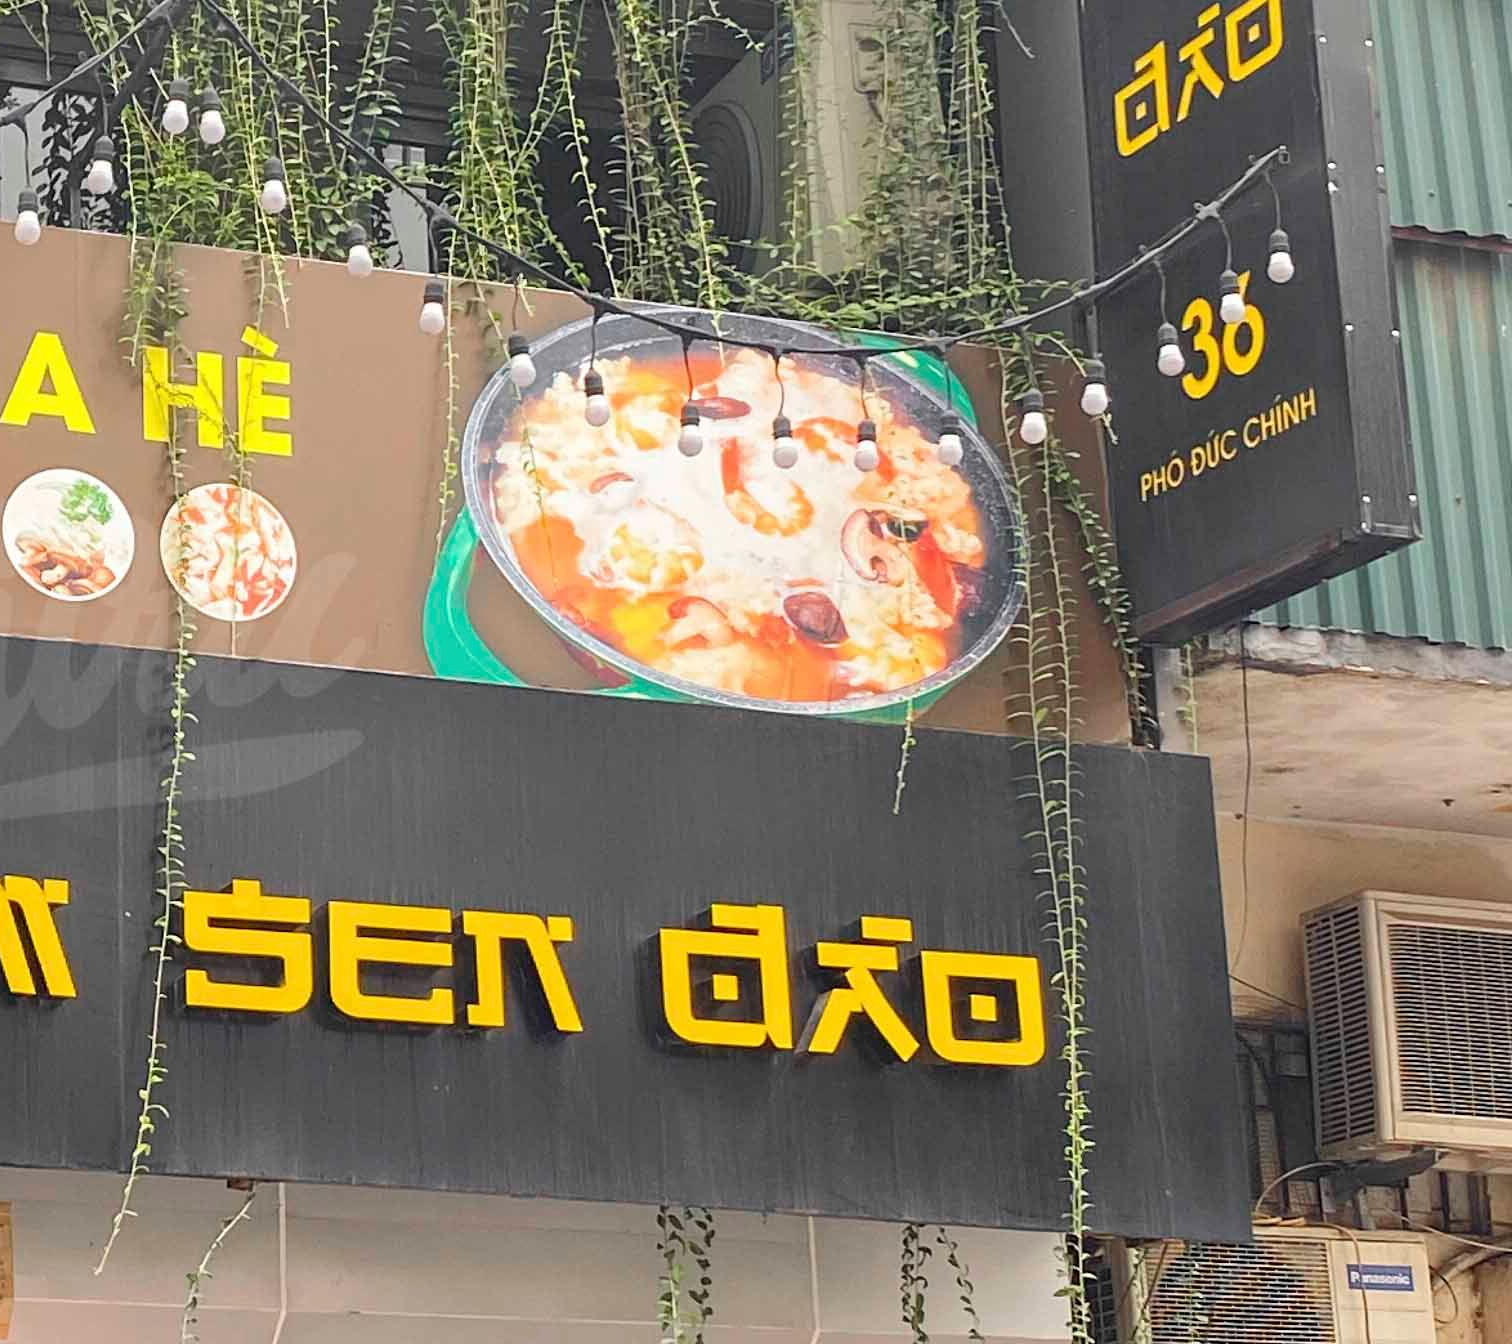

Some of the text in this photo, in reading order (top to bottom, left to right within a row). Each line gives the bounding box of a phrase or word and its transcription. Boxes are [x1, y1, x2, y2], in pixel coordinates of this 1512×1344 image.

[141, 325, 294, 458] HÈ
[1181, 268, 1266, 400] 36
[1140, 387, 1318, 502] PHÓ ĐỨC CHÍNH
